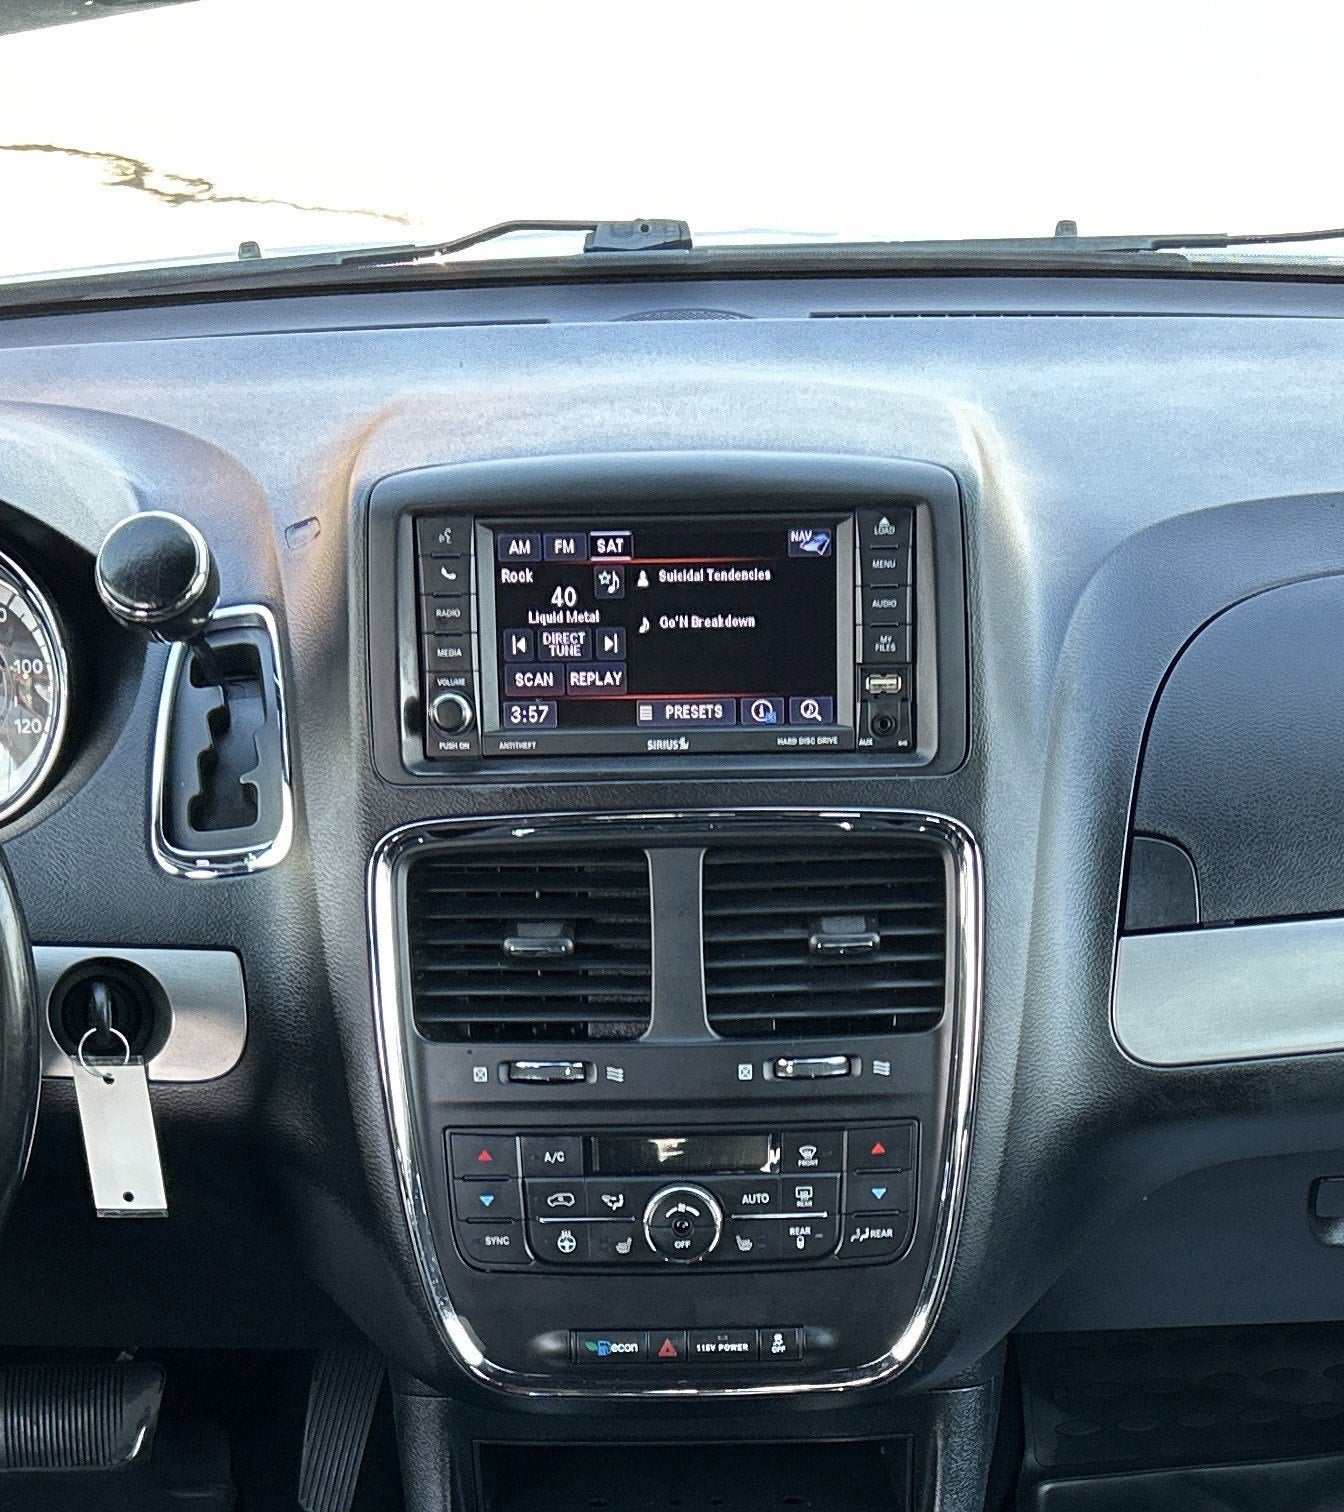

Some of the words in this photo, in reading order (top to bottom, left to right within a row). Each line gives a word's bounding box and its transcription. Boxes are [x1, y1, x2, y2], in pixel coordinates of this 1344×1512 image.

[791, 531, 812, 542] NAV
[509, 540, 530, 554] AM
[555, 539, 574, 554] FM
[597, 538, 624, 553] SAT
[872, 560, 896, 568] MENU
[501, 568, 534, 583] Rock
[659, 569, 704, 582] Suicidal
[707, 568, 771, 582] Tendencies
[551, 586, 577, 607] 40
[872, 599, 897, 608] AUDIO
[436, 608, 460, 617] RADIO
[528, 611, 564, 626] Liquid
[566, 610, 600, 624] Metal
[692, 614, 756, 628] Breakdown
[542, 632, 586, 645] DIRECT
[437, 648, 462, 658] MEDIA
[549, 645, 581, 657] TUNE
[14, 660, 43, 674] 100
[515, 672, 554, 687] SCAN
[570, 672, 622, 686] REPLAY
[510, 706, 549, 724] 3:57
[666, 704, 723, 720] PRESETS
[14, 718, 43, 734] 120
[648, 740, 679, 750] SIRIUS
[544, 1152, 565, 1163] A/C
[742, 1193, 770, 1204] AUTO
[790, 1227, 811, 1236] REAR
[870, 1228, 893, 1239] REAR
[486, 1236, 510, 1246] SYNC
[674, 1240, 691, 1249] OFF
[611, 1342, 638, 1353] econ
[718, 1343, 749, 1352] POWER
